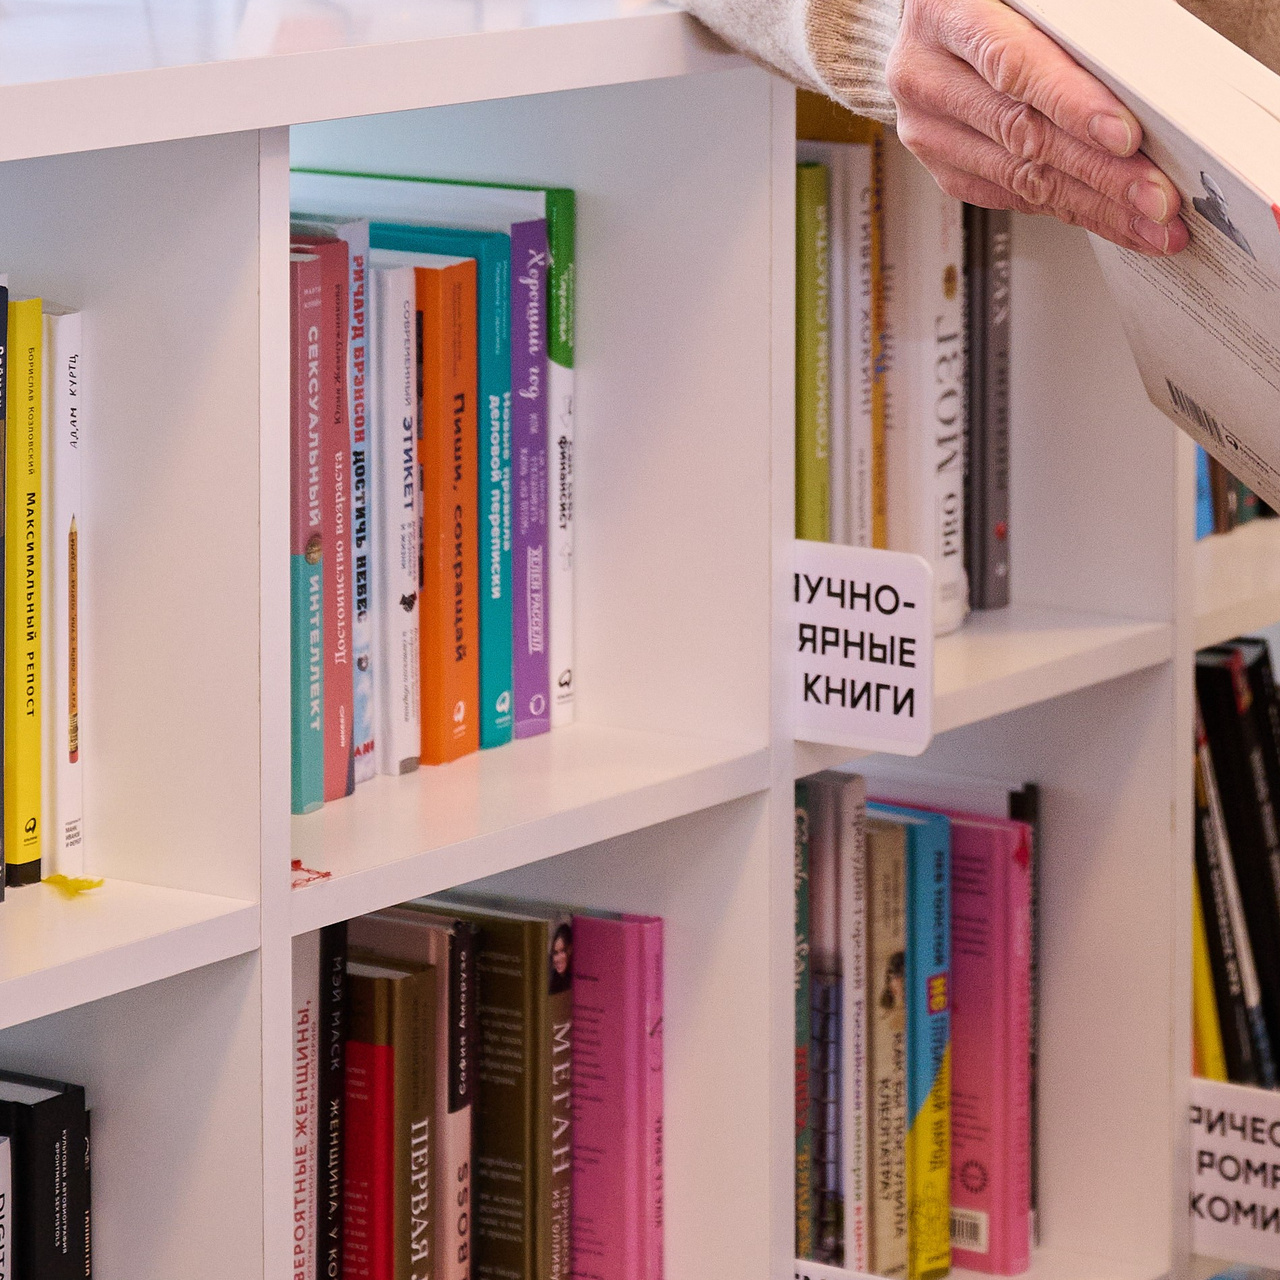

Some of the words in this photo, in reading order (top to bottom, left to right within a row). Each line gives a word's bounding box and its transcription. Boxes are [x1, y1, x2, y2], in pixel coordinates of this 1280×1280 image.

[351, 254, 365, 341] РИЧАРД
[519, 248, 546, 356] Хороший
[67, 354, 79, 397] КУРТЦ
[352, 346, 366, 443] БРЭНСОН
[519, 366, 541, 400] год
[934, 315, 959, 477] МОЗГ
[68, 407, 79, 449] АДАМ
[307, 325, 321, 526] СЕКСУАЛЬНЫЙ
[402, 416, 414, 512] ЭТИКЕТ
[452, 393, 466, 491] Пиши,
[489, 394, 502, 483] деловой
[334, 451, 346, 535] возраста
[353, 450, 368, 548] ДОСТИЧЬ
[26, 492, 37, 642] МАКСИМАЛЬНЫЙ
[355, 556, 368, 624] НЕБЕС
[452, 505, 468, 662] сокращай
[489, 489, 502, 600] переписки
[334, 541, 347, 665] Достоинство
[798, 623, 916, 669] ЯРНЫЕ
[26, 651, 36, 718] РЕПОСТ
[308, 575, 321, 731] ИНТЕЛЛЕКТ
[804, 672, 915, 718] КНИГИ
[331, 955, 343, 1002] МЭЙ
[294, 1000, 311, 1138] ЖЕНЩИНЫ,
[330, 1010, 341, 1072] МАСК
[551, 1020, 571, 1176] МЕГАН
[327, 1098, 341, 1221] ЖЕНЩИНА,
[410, 1117, 430, 1266] ПЕРВАЯ
[327, 1249, 339, 1280] КО
